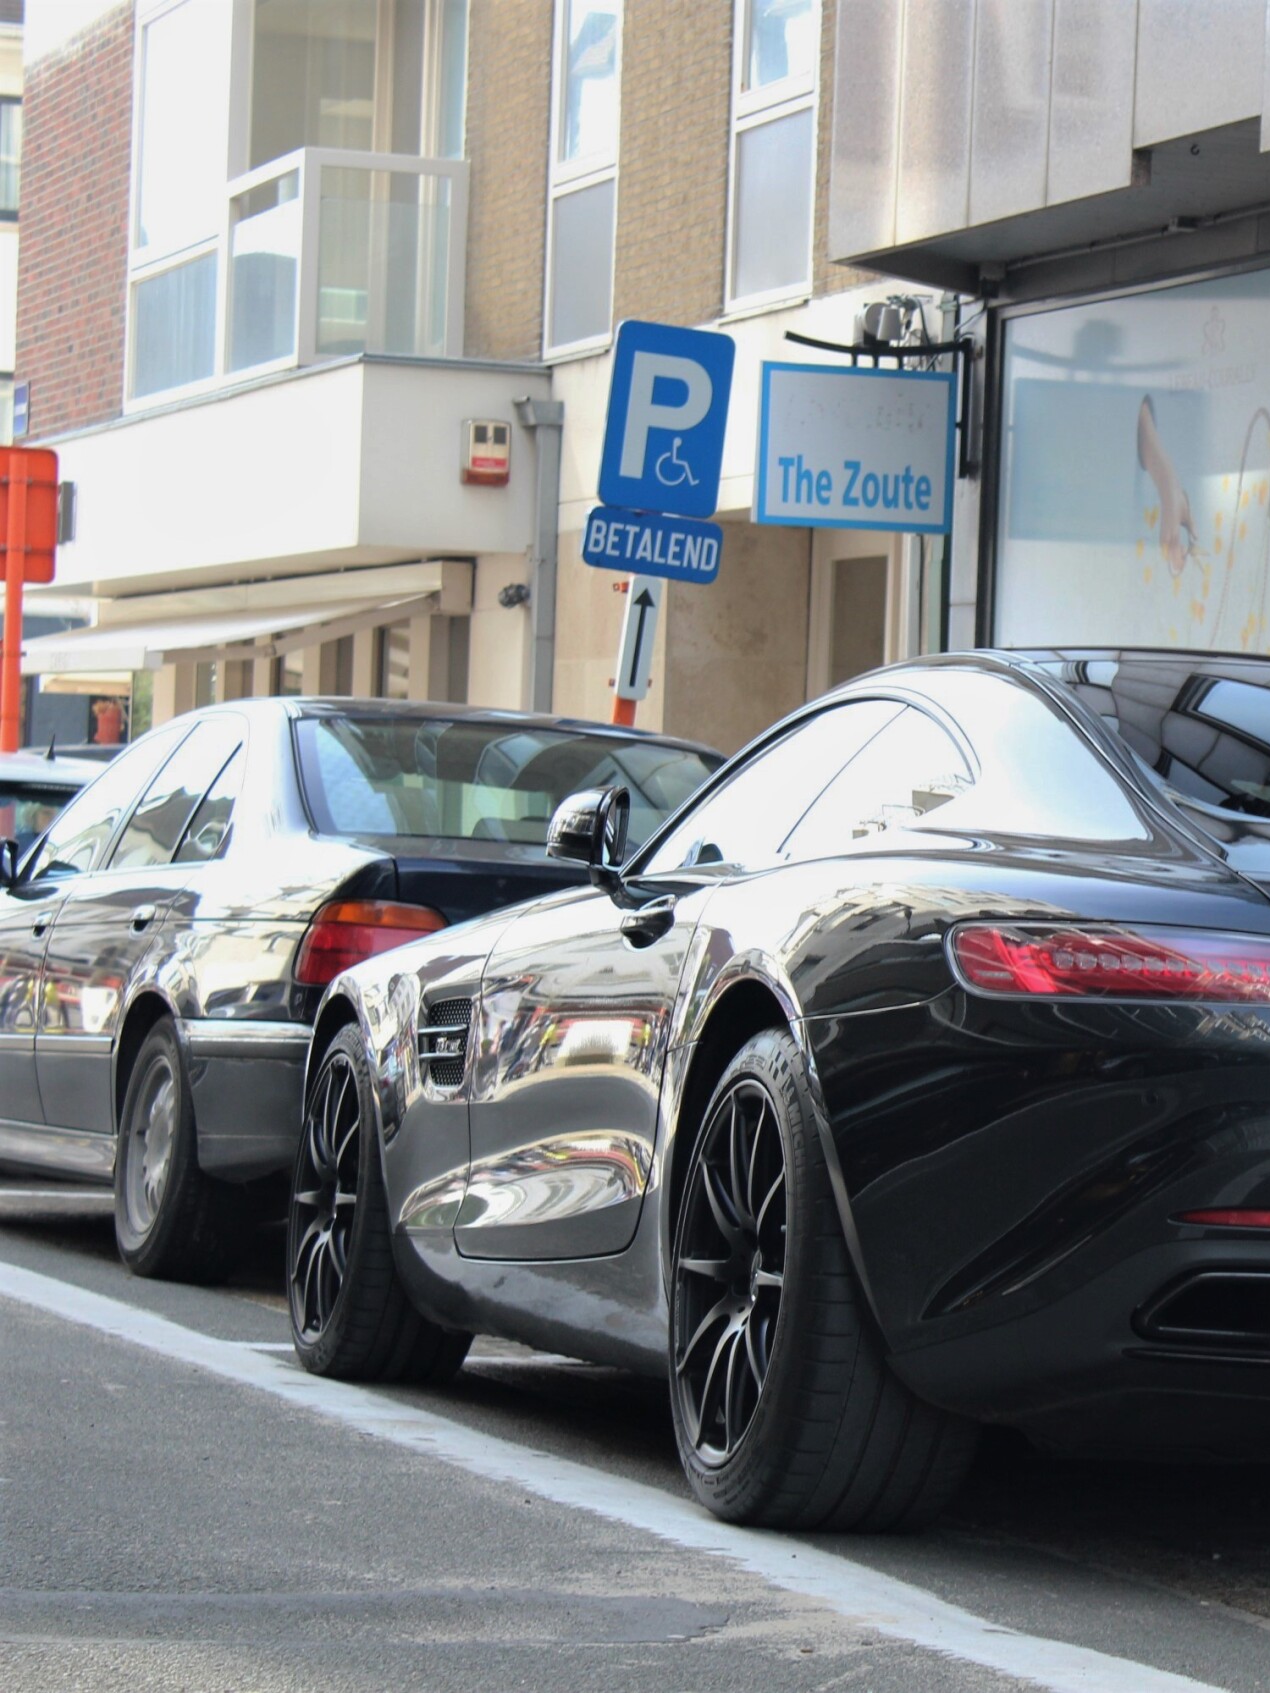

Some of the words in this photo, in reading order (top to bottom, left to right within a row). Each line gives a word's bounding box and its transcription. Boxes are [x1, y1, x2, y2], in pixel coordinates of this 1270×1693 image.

[619, 350, 713, 480] P
[778, 454, 832, 507] The
[842, 459, 932, 511] Zoute
[586, 518, 720, 572] BETALEND
